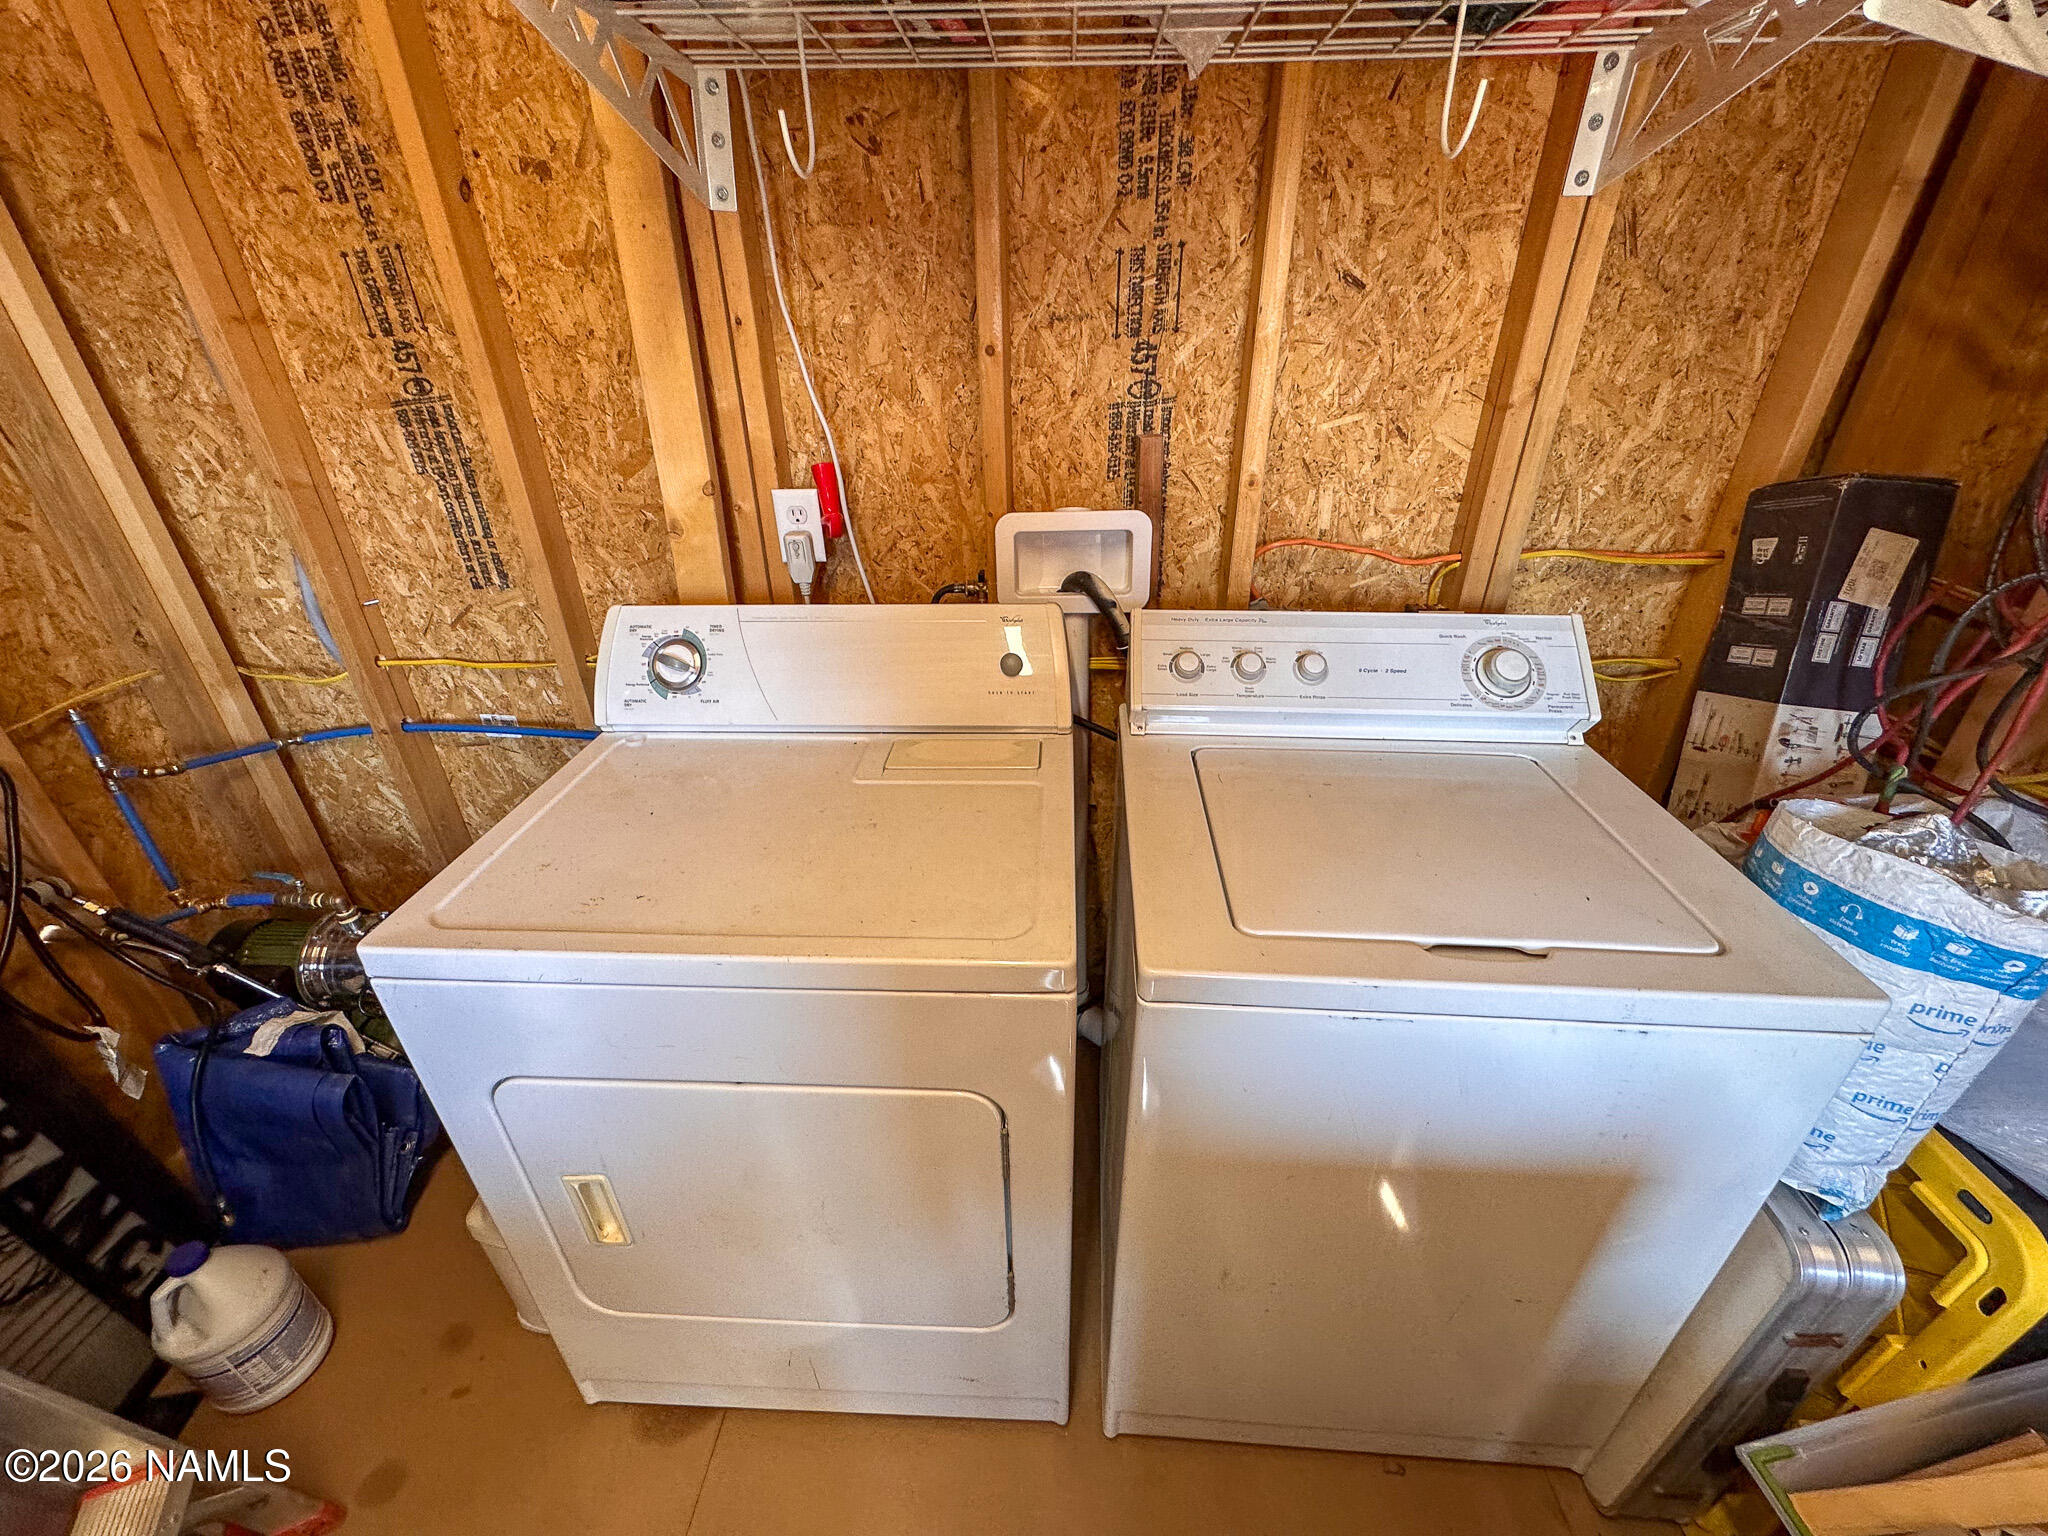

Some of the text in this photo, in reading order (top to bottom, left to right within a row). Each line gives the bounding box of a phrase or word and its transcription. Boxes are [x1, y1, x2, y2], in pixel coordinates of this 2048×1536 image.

[329, 118, 363, 189] THICKNESS
[1156, 110, 1175, 182] THICKNESS
[365, 166, 384, 194] CAT
[353, 246, 373, 275] THIS
[1129, 245, 1145, 272] THIS
[1153, 242, 1172, 305] STRENGTH
[376, 245, 415, 334] STRENGTH AXIS
[389, 334, 422, 379] 457
[1130, 338, 1158, 376] 457
[1908, 1003, 1977, 1027] prime
[1851, 1091, 1914, 1115] prime
